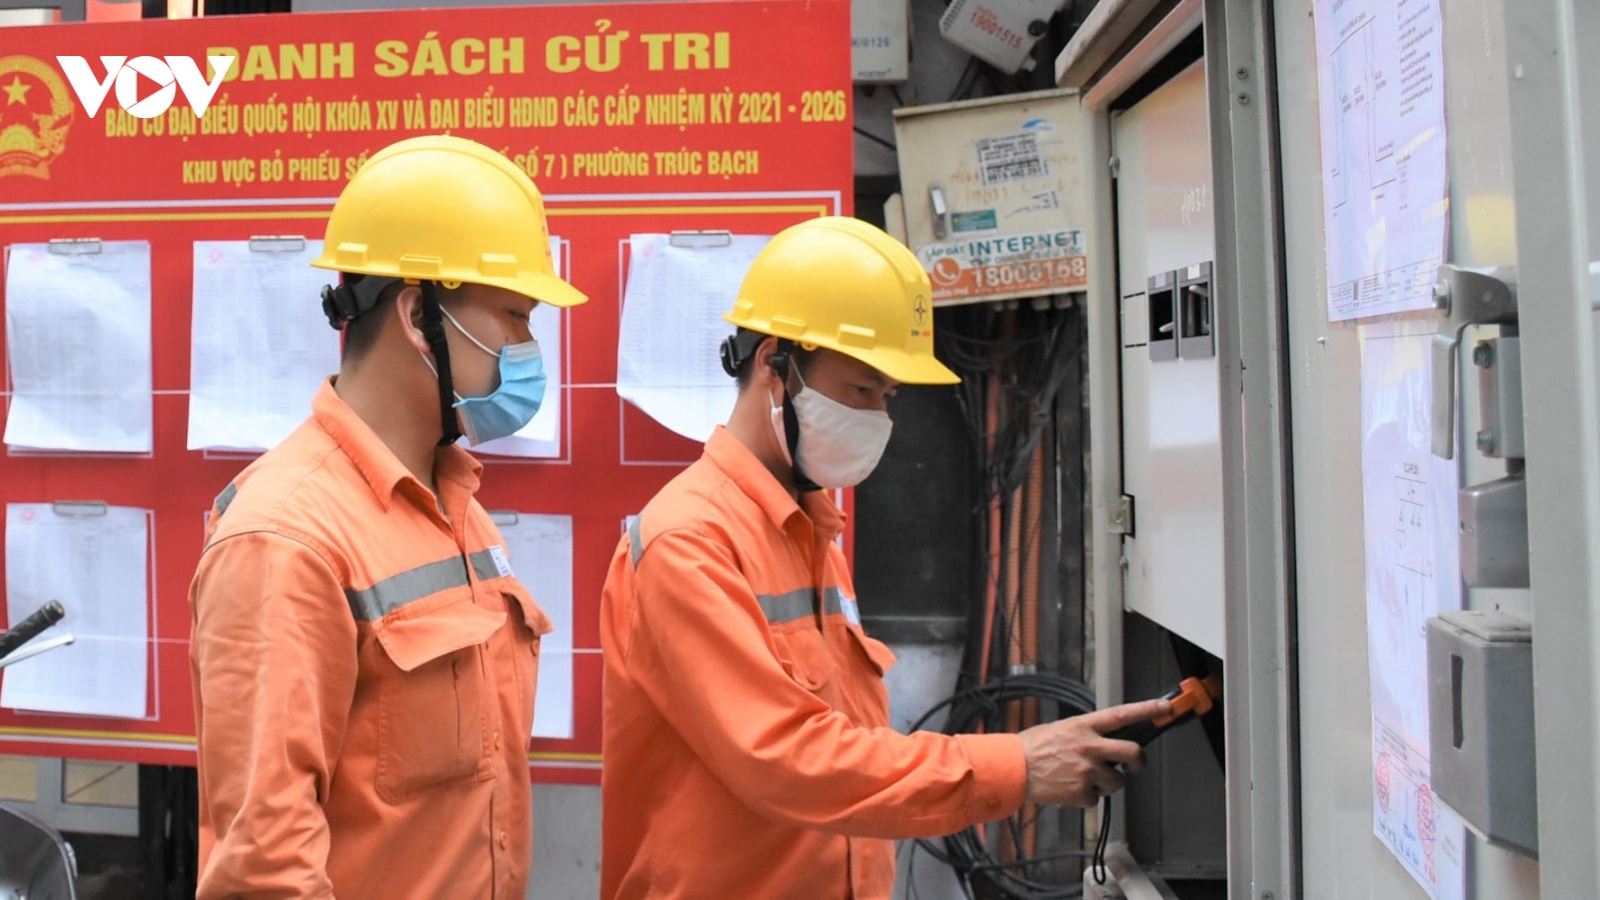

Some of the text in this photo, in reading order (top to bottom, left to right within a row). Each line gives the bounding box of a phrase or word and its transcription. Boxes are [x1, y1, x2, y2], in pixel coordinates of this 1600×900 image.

[206, 18, 730, 82] DANH SÁCH CỬ TRI
[168, 105, 197, 142] ĐẠI
[201, 92, 238, 135] BIỂU
[243, 92, 289, 137] QUỐC
[292, 95, 321, 139] HỘI
[325, 94, 372, 132] KHÓA
[375, 99, 399, 131] XV
[402, 92, 426, 130] VÀ
[430, 98, 460, 135] ĐẠI
[464, 85, 505, 129] BIỂU
[509, 96, 558, 128] HĐND
[563, 89, 600, 127] CÁC
[604, 83, 640, 126] CẤP
[645, 87, 705, 132] NHIỆM
[709, 86, 734, 124] KỲ
[738, 91, 781, 124] 2021
[800, 90, 847, 123] 2026
[182, 160, 217, 184] KHU
[221, 156, 256, 188] VỰC
[260, 149, 284, 182] BỎ
[288, 149, 341, 181] PHIẾU
[513, 146, 539, 178] SỐ
[543, 154, 555, 178] 7
[573, 146, 649, 178] PHƯỜNG
[654, 146, 703, 176] TRÚC
[707, 150, 760, 180] BẠCH
[969, 230, 1080, 256] INTERNET
